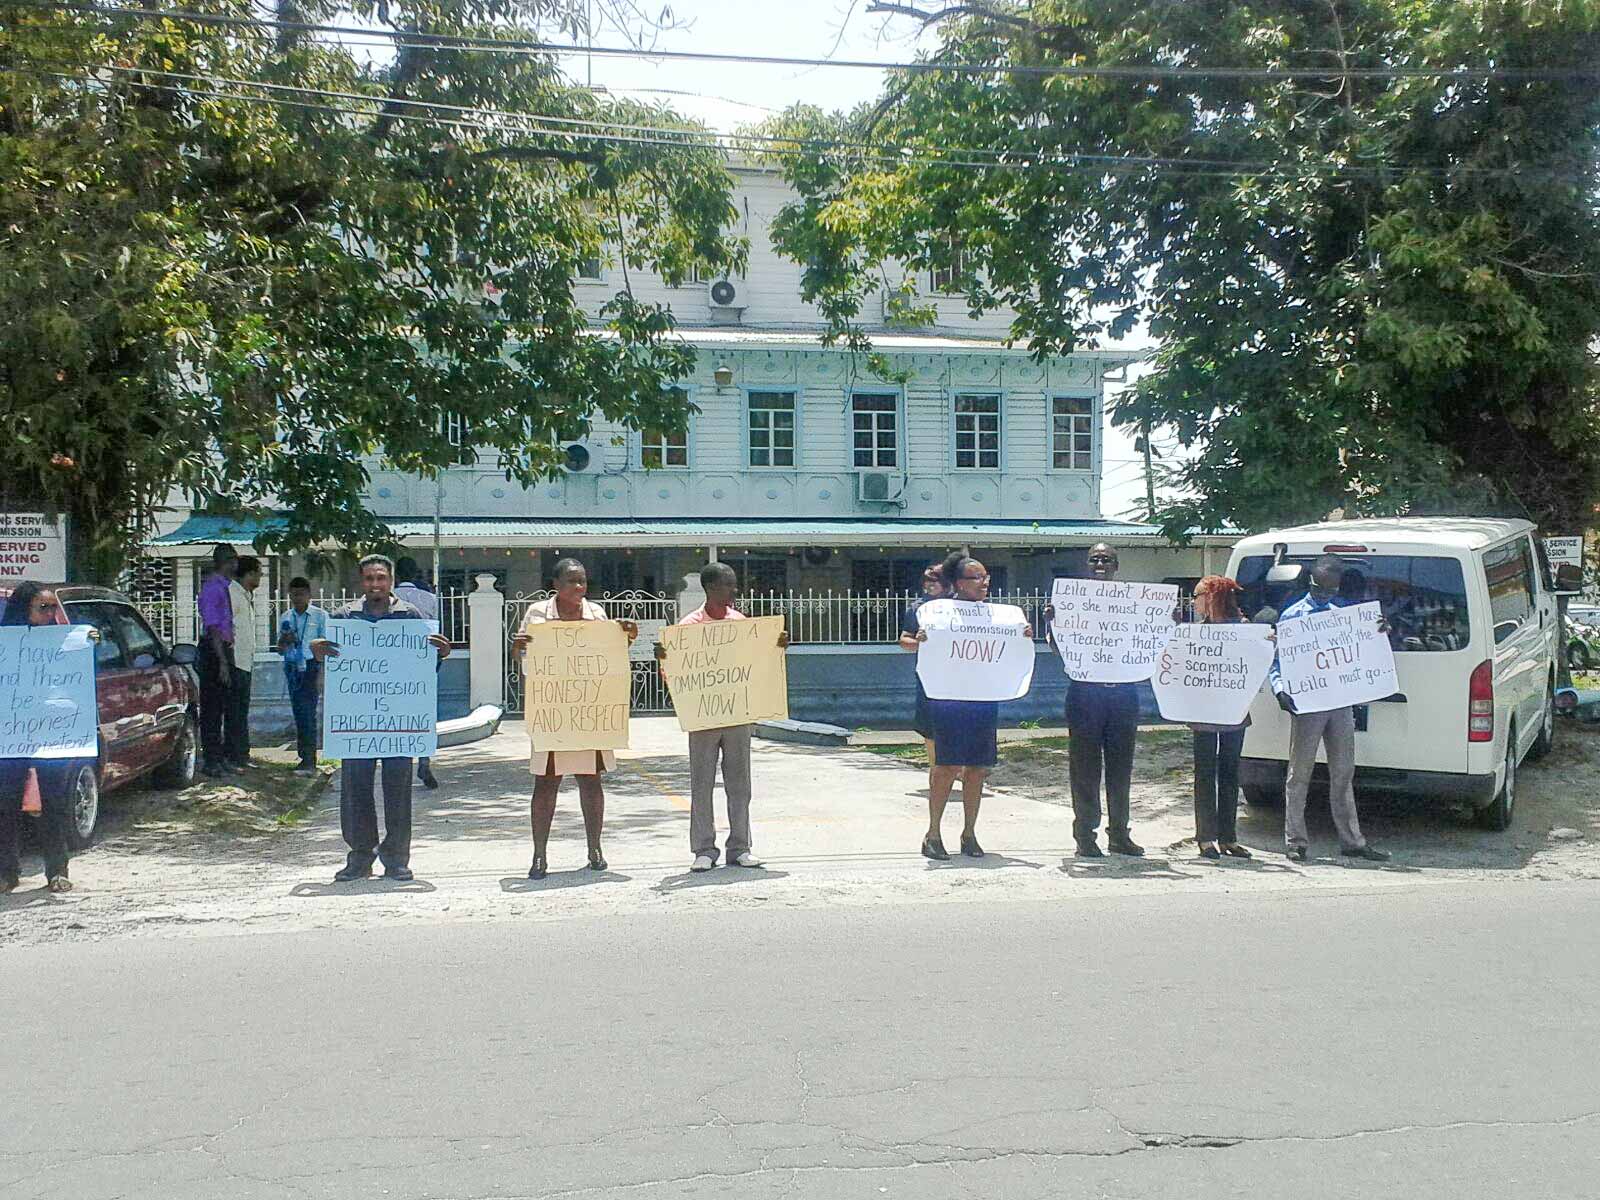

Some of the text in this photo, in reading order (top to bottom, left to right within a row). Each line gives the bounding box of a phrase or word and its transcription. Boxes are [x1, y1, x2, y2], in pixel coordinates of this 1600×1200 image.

[1055, 581, 1087, 597] Leila
[1059, 598, 1171, 623] so she must go!
[950, 617, 1017, 636] Commission
[1053, 613, 1173, 635] Leila was never
[1200, 625, 1238, 641] Class
[1300, 616, 1353, 635] Ministry
[328, 625, 428, 659] The Teaching
[552, 627, 586, 648] TSC
[663, 627, 689, 651] WE
[701, 623, 738, 647] NEED
[1057, 633, 1064, 643] a
[1069, 631, 1123, 648] teacher
[950, 639, 1006, 663] NOW!
[1092, 648, 1114, 663] she
[1185, 641, 1223, 656] tired
[1316, 642, 1360, 670] GTU!
[326, 656, 389, 672] Service
[533, 654, 608, 676] WE NEED
[681, 648, 720, 669] NEW
[1185, 657, 1248, 675] scampish
[340, 677, 426, 695] Commission
[1184, 672, 1246, 690] confused
[1288, 674, 1328, 695] Leila
[532, 679, 602, 704] HONESTY
[330, 713, 430, 732] FRUSTRATING
[532, 703, 628, 733] AND RESPECT
[342, 735, 427, 753] TEACHERS
